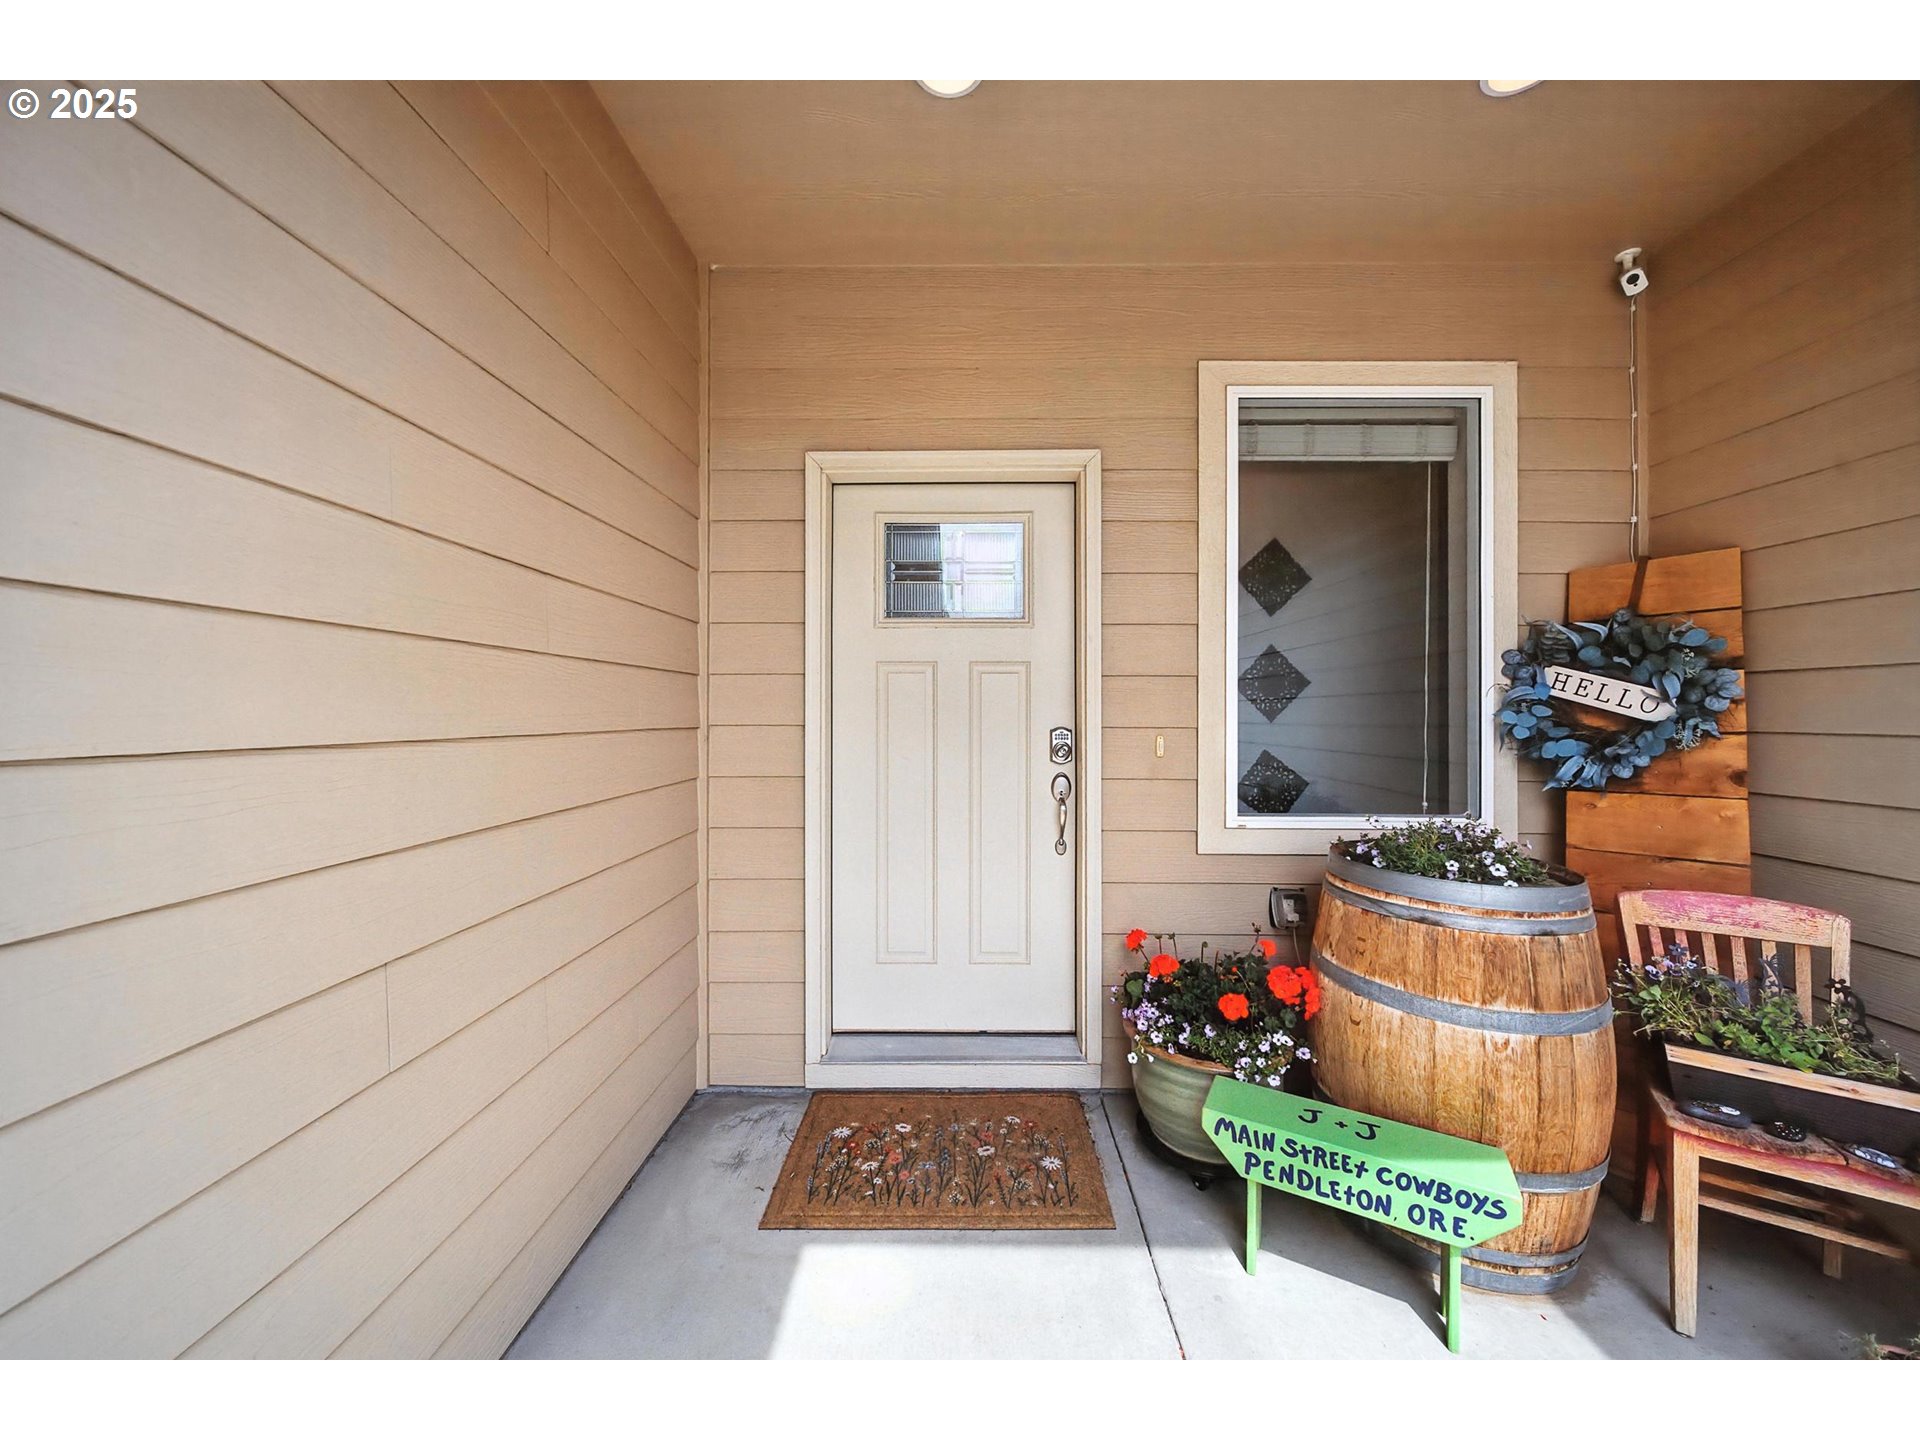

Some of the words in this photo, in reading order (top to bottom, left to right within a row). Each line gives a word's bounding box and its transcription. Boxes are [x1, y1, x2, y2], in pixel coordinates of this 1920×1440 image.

[1552, 672, 1659, 713] HELLO
[1298, 1109, 1323, 1124] J
[1354, 1120, 1381, 1141] J
[1214, 1117, 1276, 1151] MAIN
[1376, 1167, 1508, 1220] COWBOYS
[1407, 1203, 1475, 1241] ORE.
